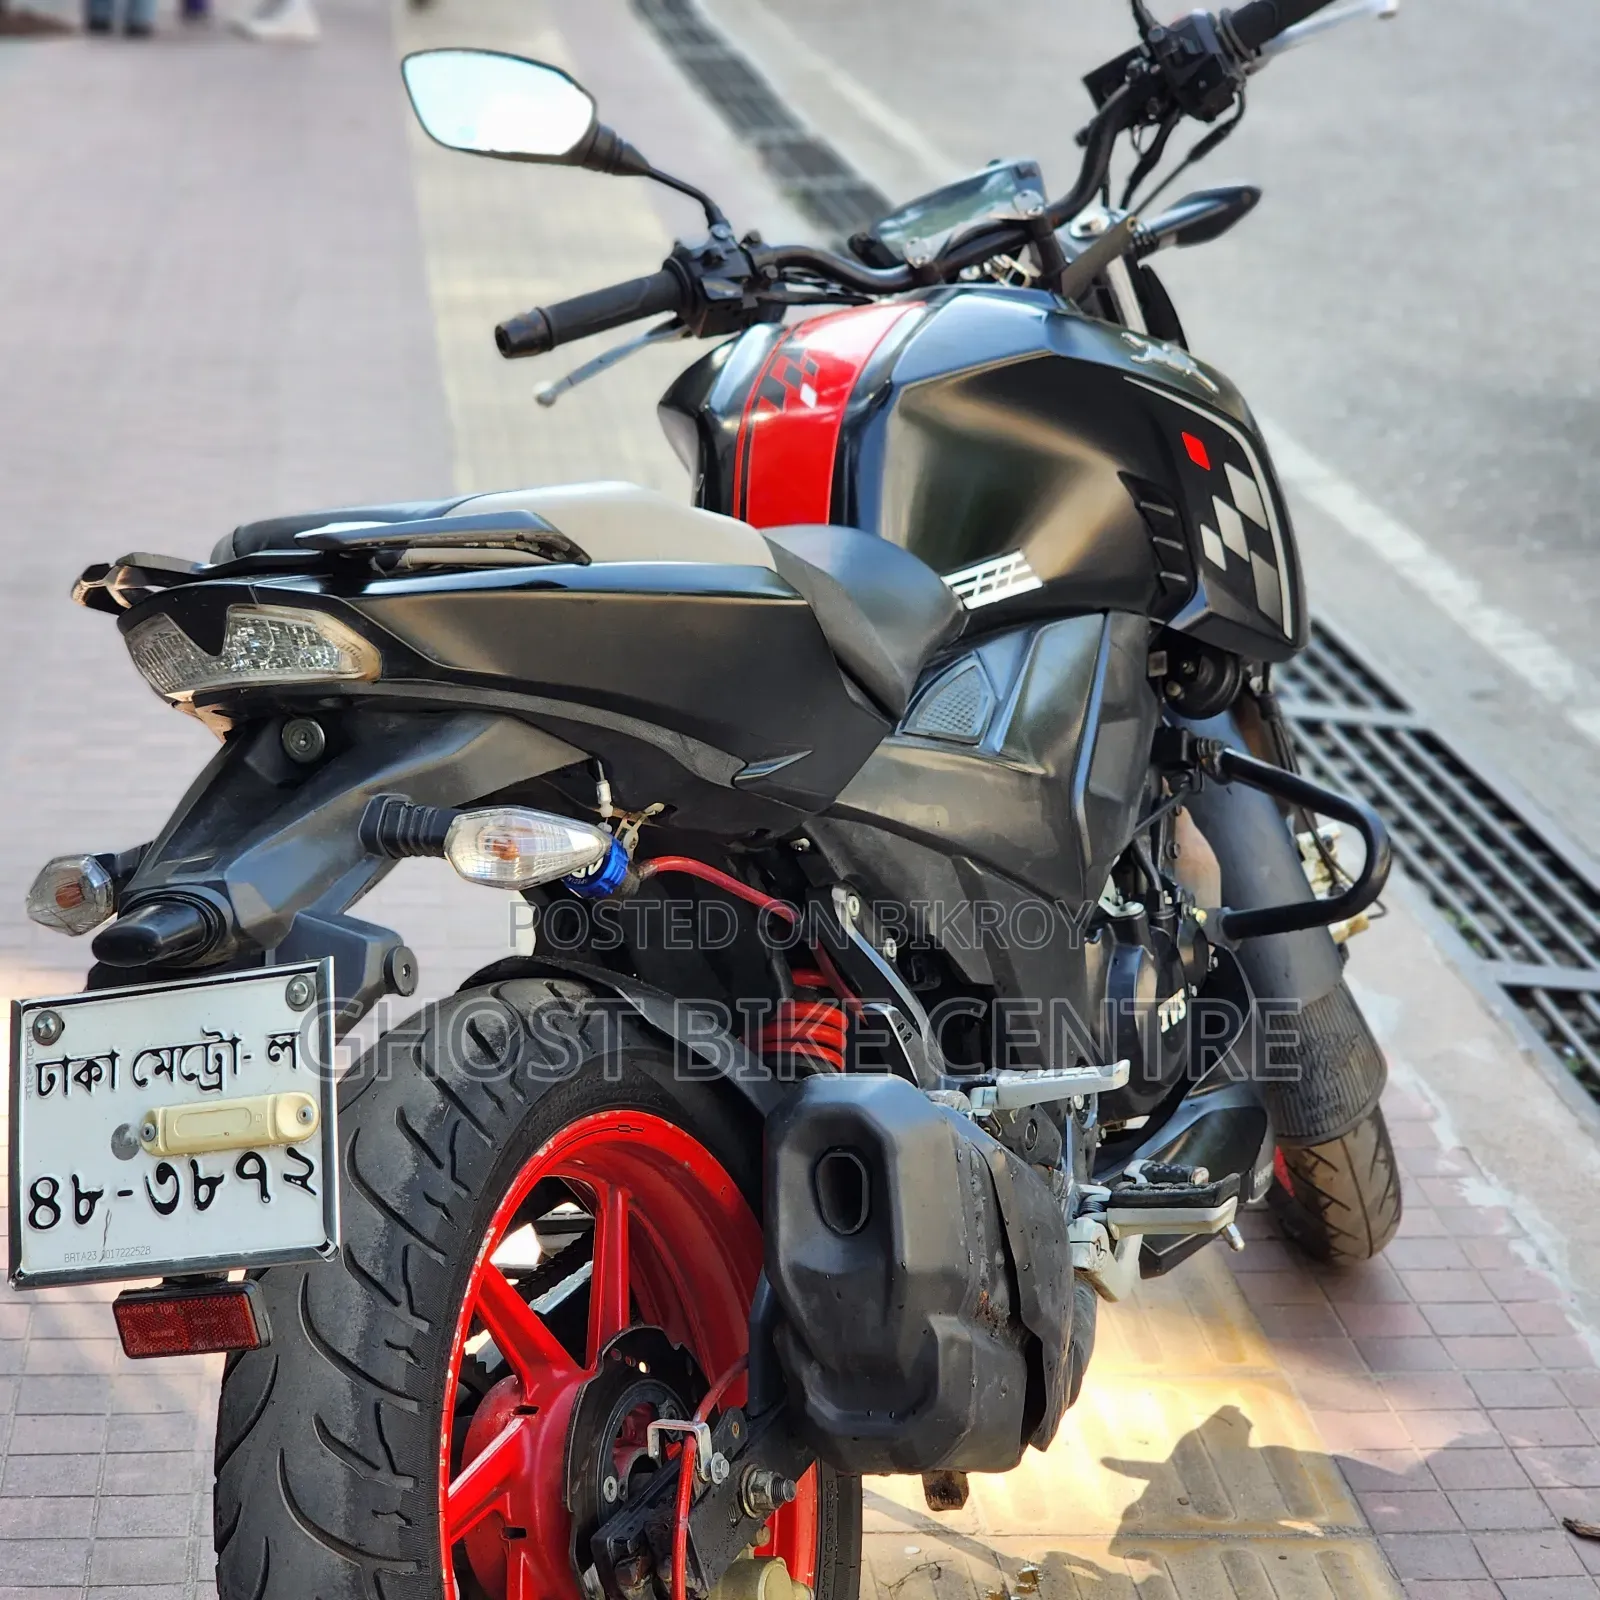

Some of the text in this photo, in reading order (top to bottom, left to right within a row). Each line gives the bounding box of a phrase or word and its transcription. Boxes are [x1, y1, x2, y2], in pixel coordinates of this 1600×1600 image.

[1158, 987, 1186, 1033] TVS
[36, 1050, 120, 1096] ঢাকা
[266, 1030, 301, 1069] ল
[64, 1250, 97, 1263] BRTA23
[825, 1481, 834, 1552] DESIGNED
